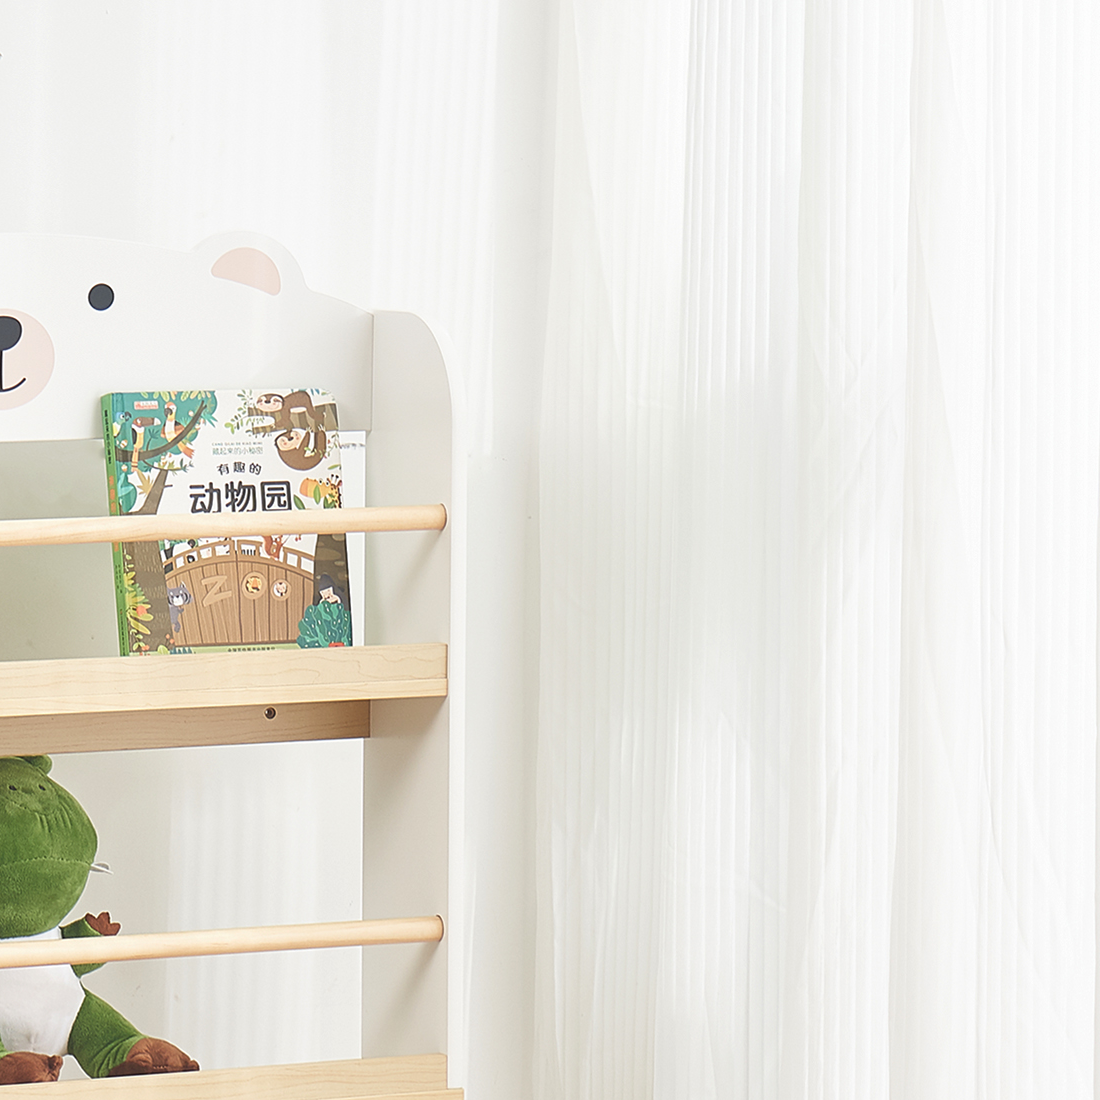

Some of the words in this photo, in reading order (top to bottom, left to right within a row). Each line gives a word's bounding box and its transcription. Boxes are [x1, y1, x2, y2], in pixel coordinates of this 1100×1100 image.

[216, 461, 262, 476] 有趣的
[189, 480, 292, 513] 动物园
